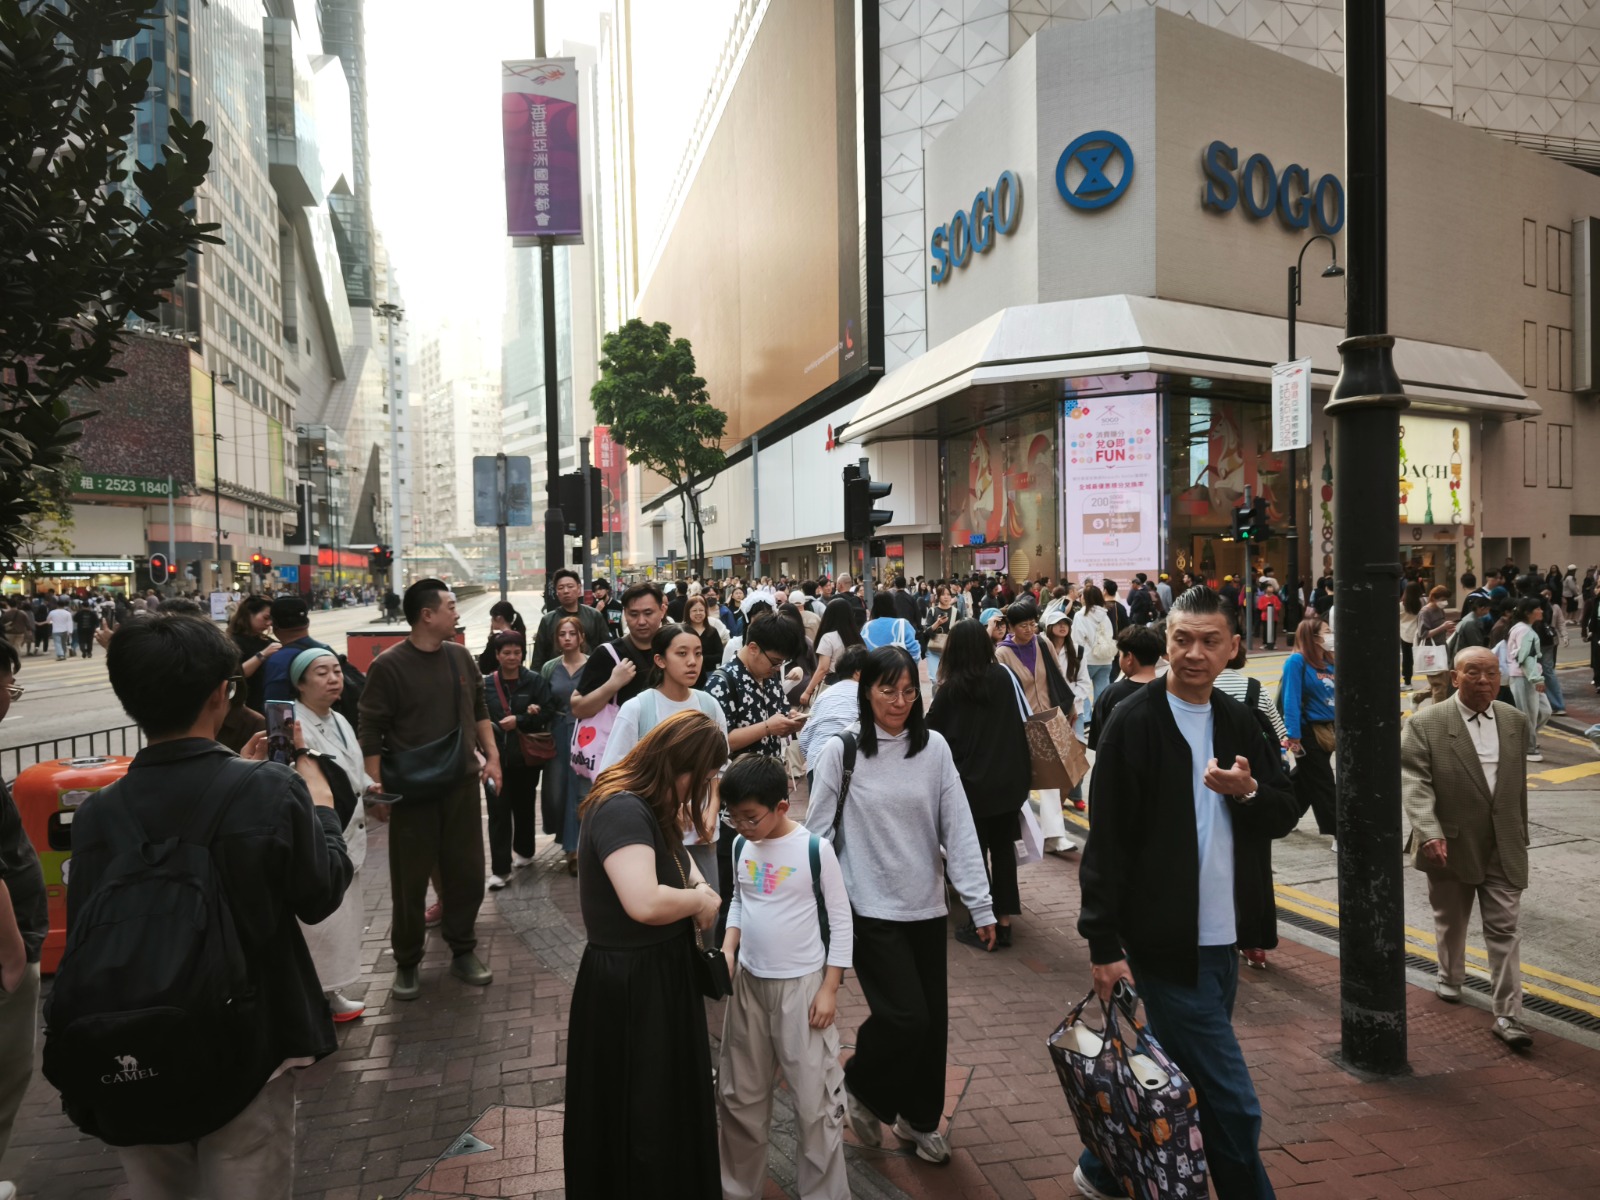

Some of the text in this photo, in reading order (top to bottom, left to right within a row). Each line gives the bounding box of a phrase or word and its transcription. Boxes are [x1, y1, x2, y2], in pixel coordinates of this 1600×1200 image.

[531, 104, 551, 226] 香港亞洲國際都會
[1203, 139, 1345, 235] SOGO
[931, 169, 1021, 285] SOGO
[1095, 449, 1126, 462] FUN
[105, 478, 136, 492] 2523
[140, 481, 169, 495] 1840
[1091, 497, 1109, 507] 200
[100, 1067, 159, 1084] CAMEL
